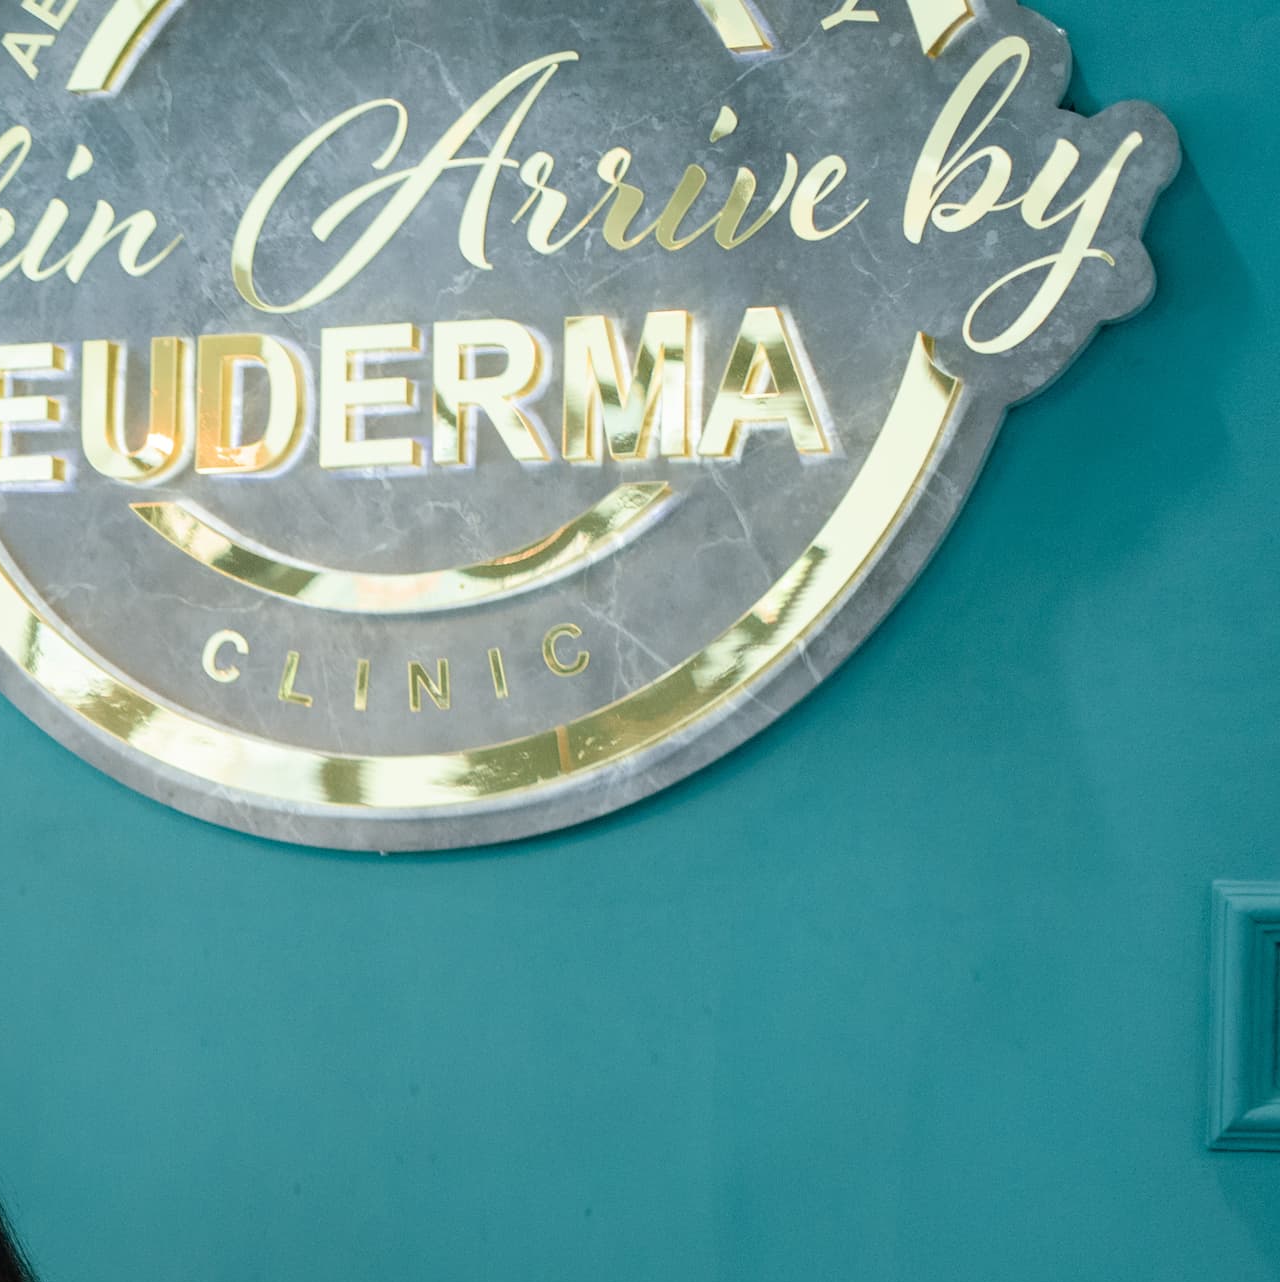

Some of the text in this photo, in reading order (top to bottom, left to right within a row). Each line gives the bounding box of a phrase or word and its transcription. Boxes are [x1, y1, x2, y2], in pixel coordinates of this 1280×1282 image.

[231, 50, 870, 314] Arrive
[902, 35, 1143, 355] by
[201, 622, 591, 712] CLINIC
